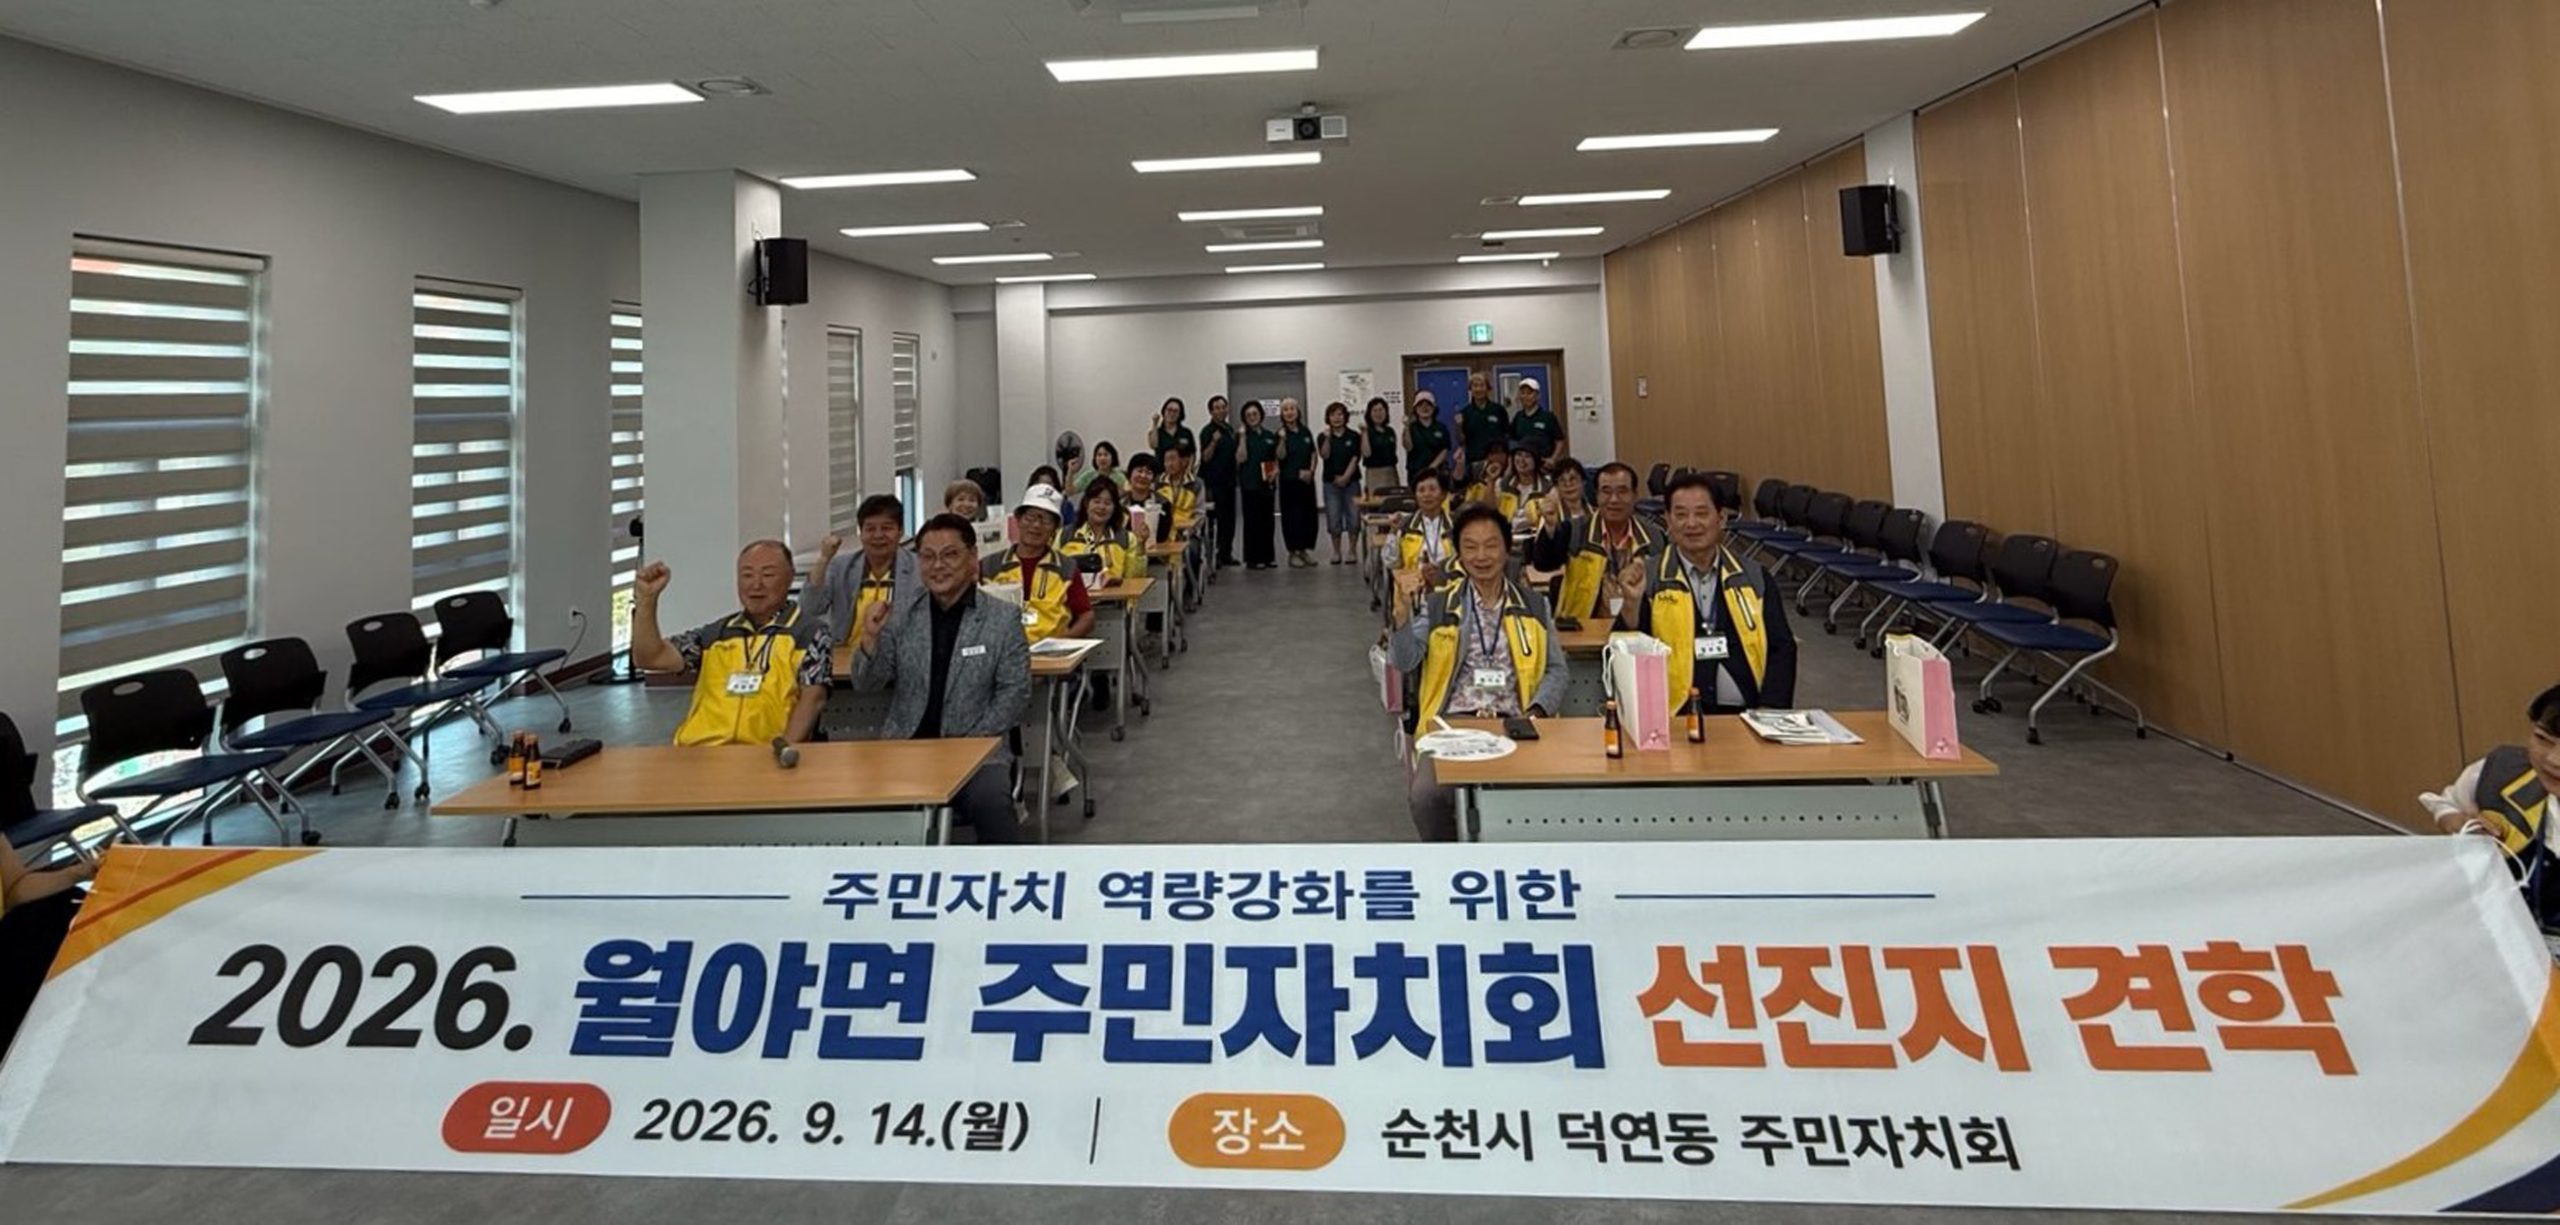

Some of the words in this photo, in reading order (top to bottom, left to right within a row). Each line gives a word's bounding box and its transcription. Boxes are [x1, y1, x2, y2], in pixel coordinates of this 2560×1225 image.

[823, 871, 1066, 921] 주민자치
[1098, 870, 1421, 922] 역량강화를
[1449, 869, 1582, 921] 위한
[187, 944, 534, 1052] 2026.
[569, 939, 935, 1062] 월야면
[970, 941, 1606, 1070] 주민자치회
[1636, 944, 2032, 1073] 선진지
[2047, 940, 2359, 1077] 견학
[484, 1097, 573, 1140] 일시
[633, 1098, 779, 1144] 2026.
[803, 1100, 844, 1146] 9.
[871, 1100, 1030, 1152] 14.(월)
[1211, 1107, 1306, 1154] 장소
[1381, 1108, 1534, 1162] 순천시
[1557, 1110, 1719, 1166] 덕연동
[1740, 1114, 2022, 1172] 주민자치회
